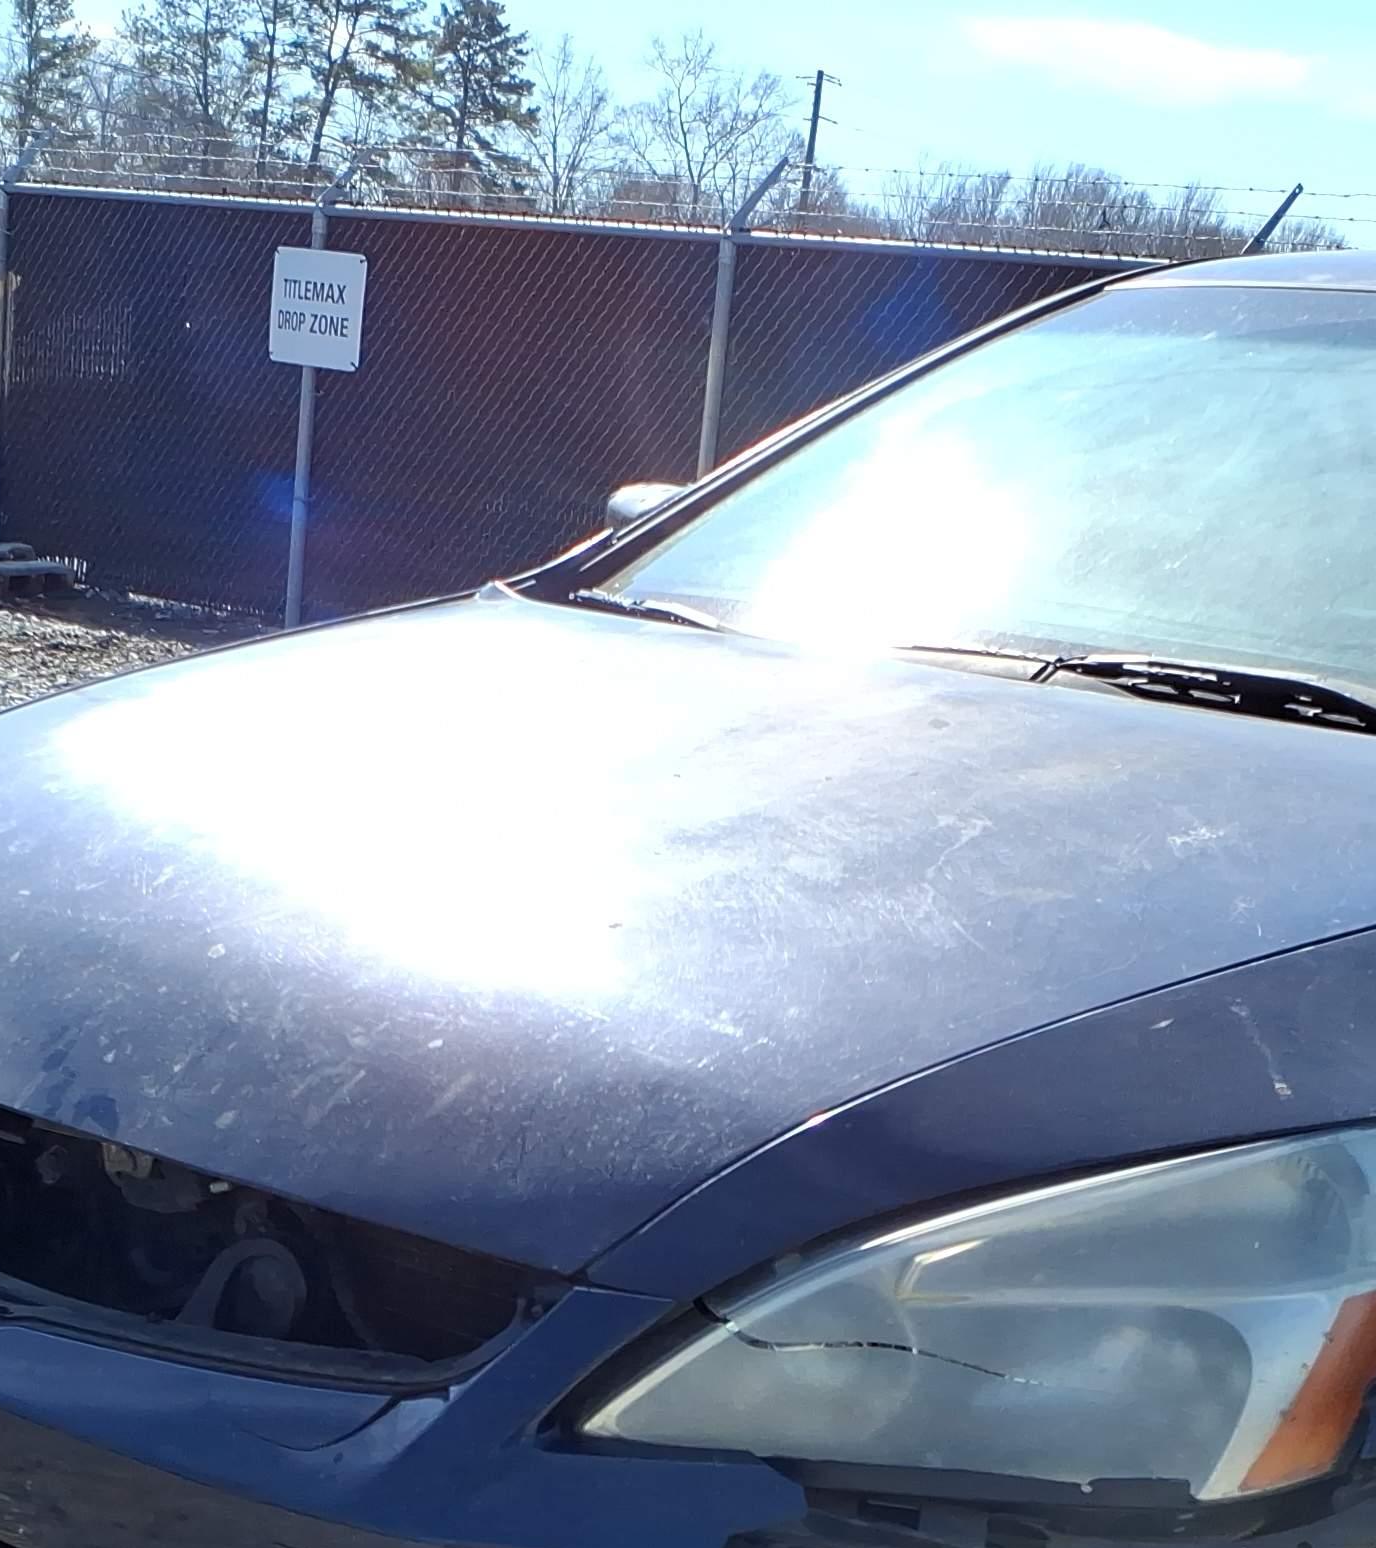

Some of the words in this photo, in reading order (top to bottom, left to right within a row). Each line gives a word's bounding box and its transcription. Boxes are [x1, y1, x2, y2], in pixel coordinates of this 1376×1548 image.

[283, 278, 347, 305] TITLEMAX
[277, 309, 306, 332] DROP
[309, 313, 349, 338] ZONE
